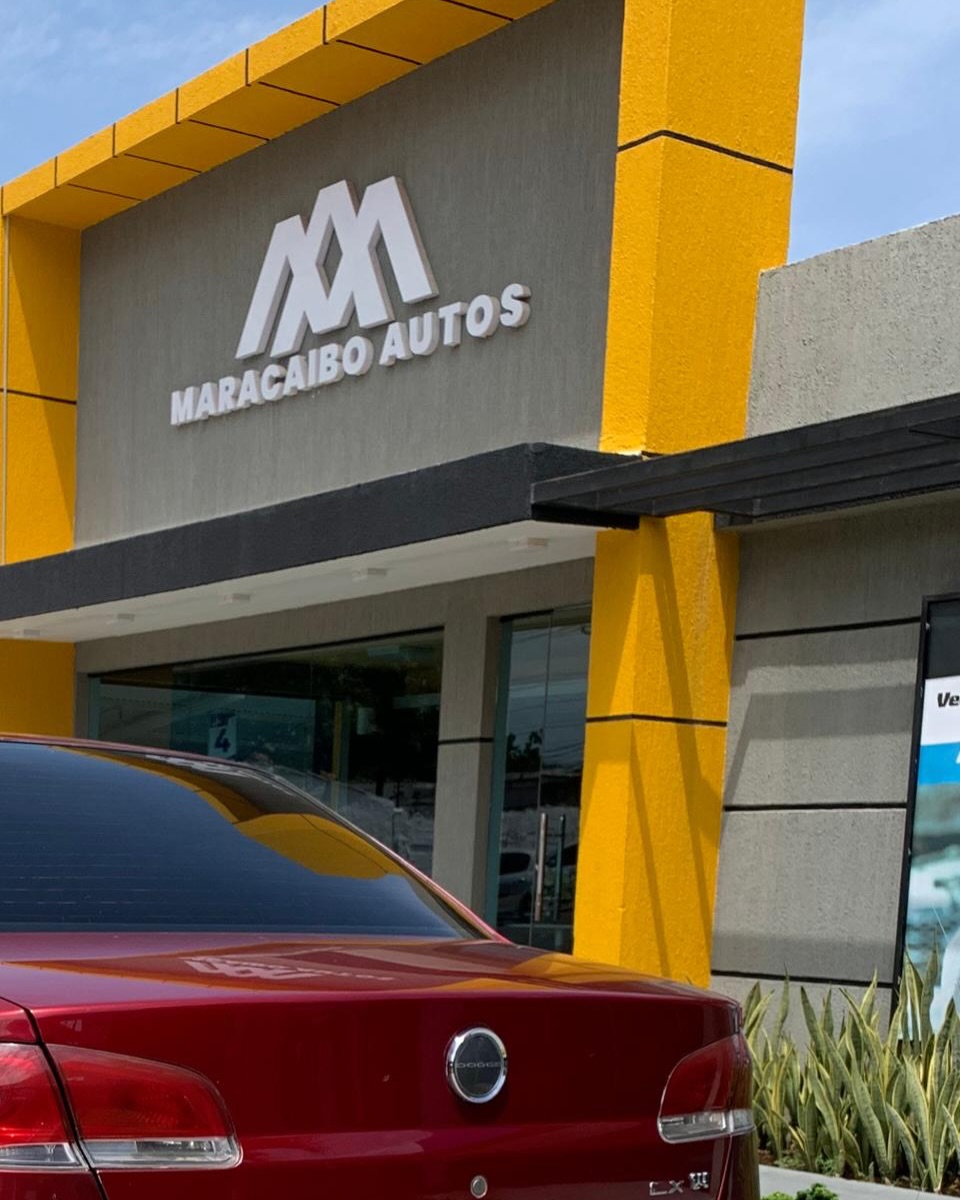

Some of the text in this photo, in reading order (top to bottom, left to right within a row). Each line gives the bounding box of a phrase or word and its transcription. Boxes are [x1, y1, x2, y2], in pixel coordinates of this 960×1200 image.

[170, 283, 531, 427] MARACAIBO AUTOS
[649, 1180, 685, 1196] LX
